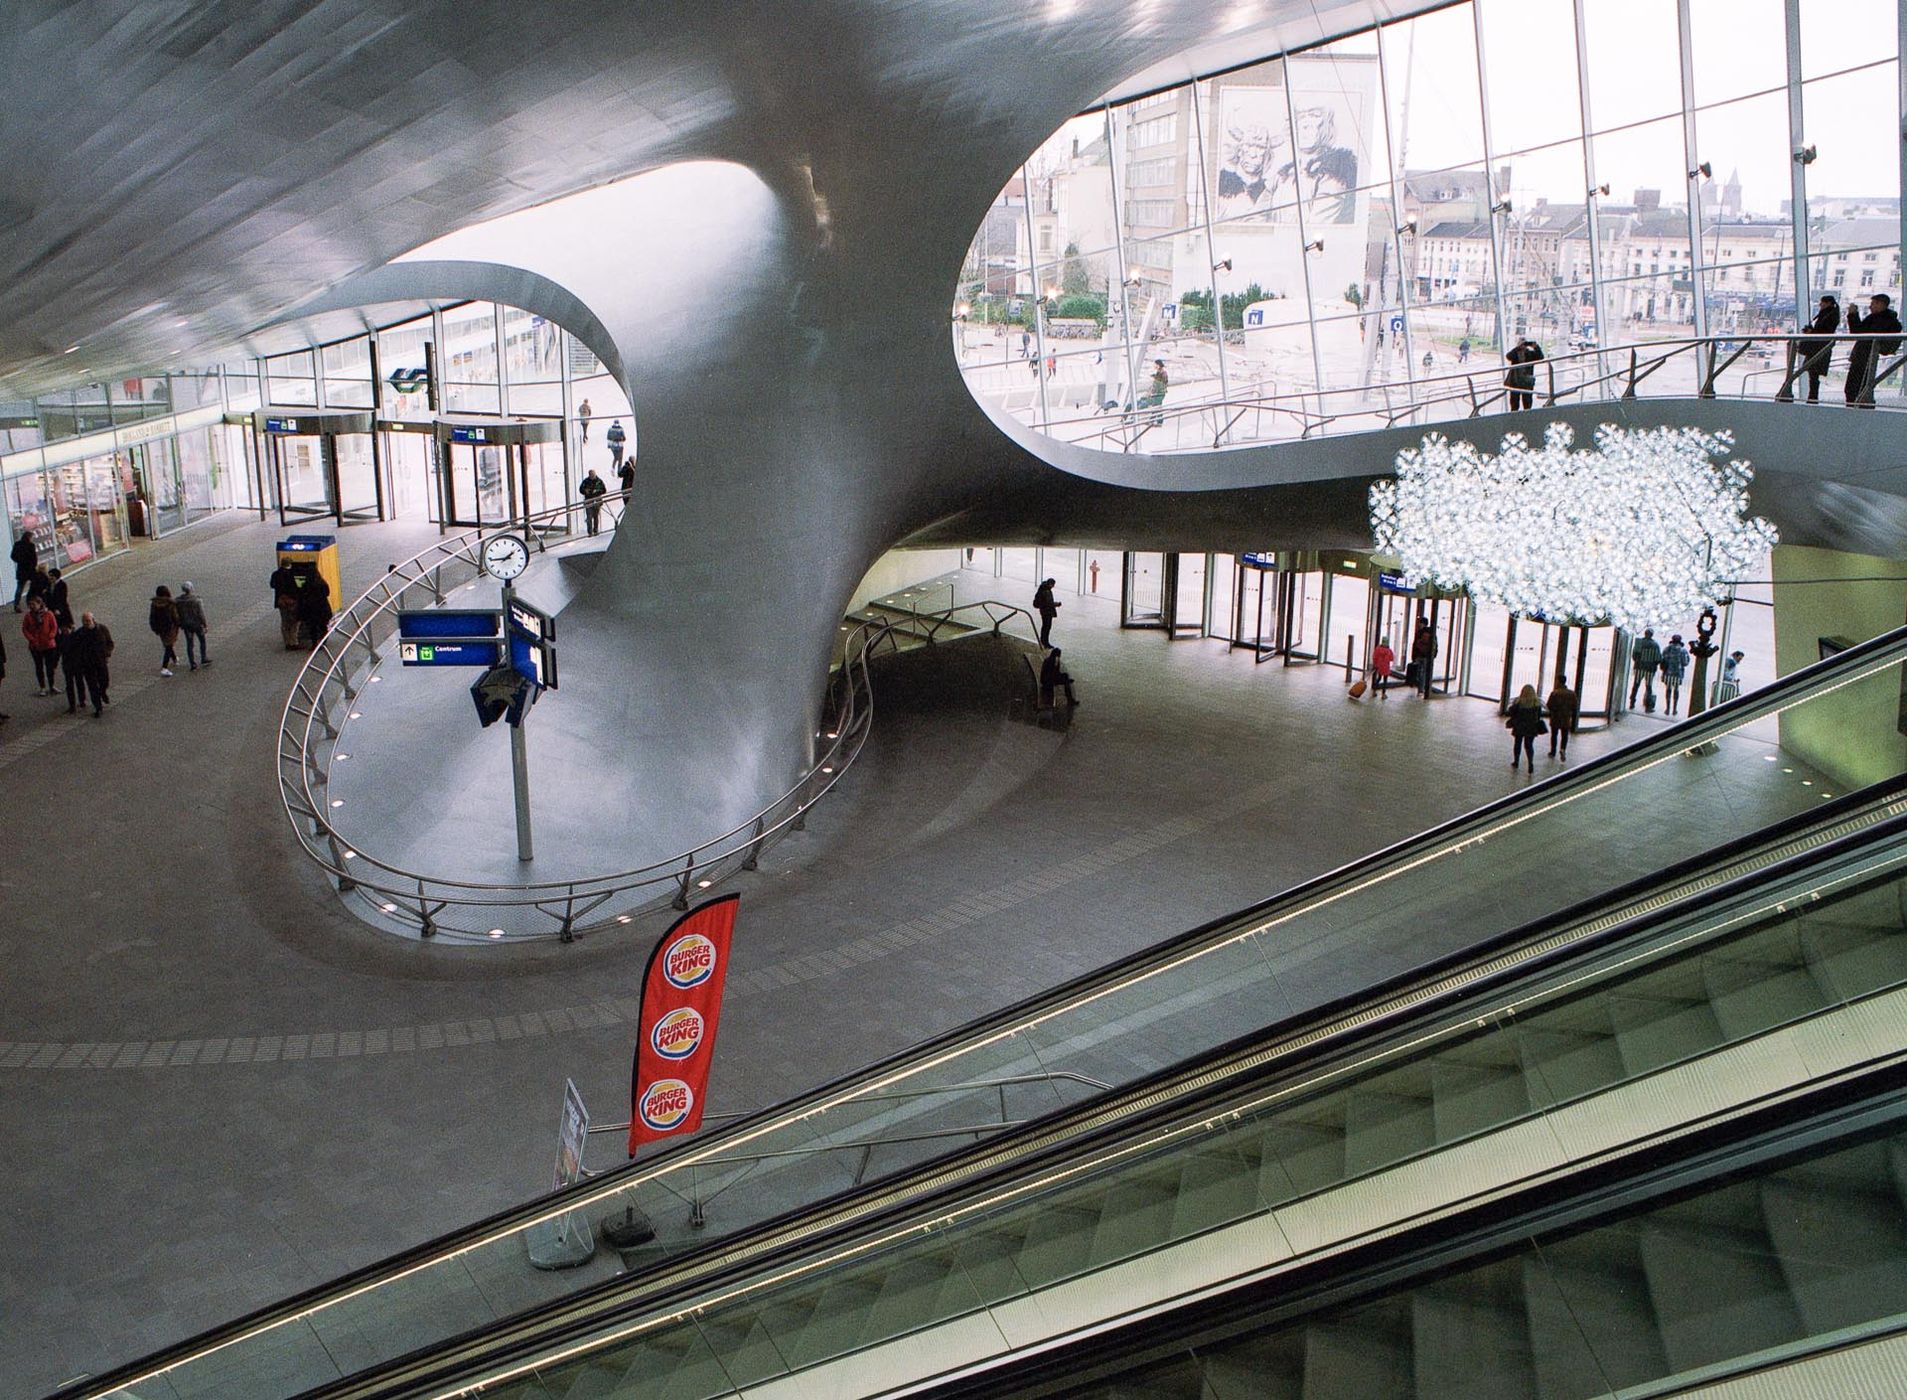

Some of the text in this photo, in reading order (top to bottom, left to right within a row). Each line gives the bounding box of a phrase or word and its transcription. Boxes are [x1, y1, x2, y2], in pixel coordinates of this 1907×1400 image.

[671, 945, 710, 964] BURGER
[671, 954, 711, 976] KING
[659, 1018, 699, 1037] BURGER
[659, 1027, 700, 1048] KING
[647, 1088, 686, 1106] BURGER
[647, 1096, 687, 1118] KING
